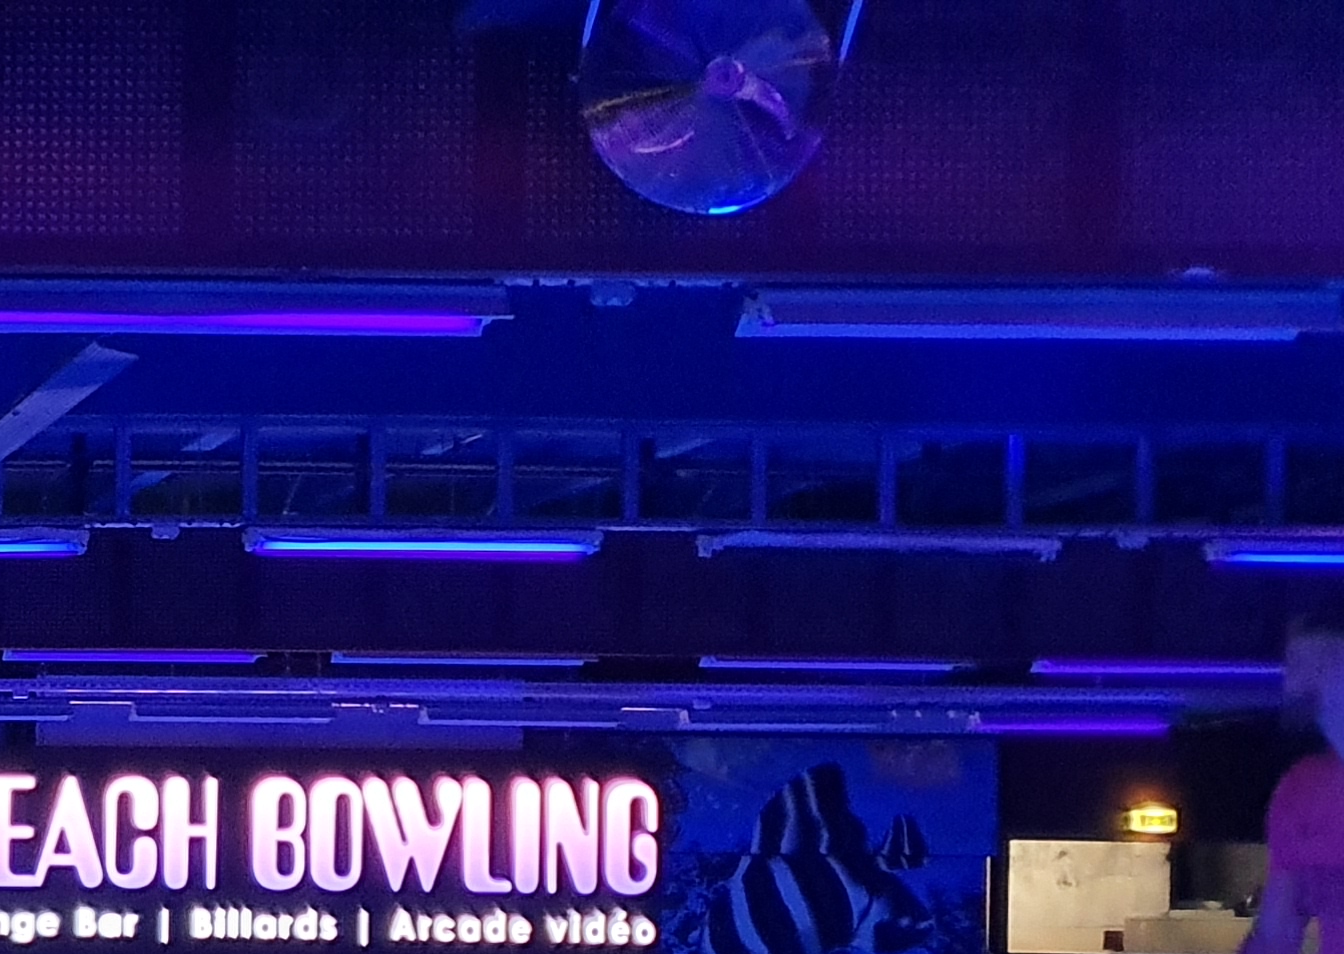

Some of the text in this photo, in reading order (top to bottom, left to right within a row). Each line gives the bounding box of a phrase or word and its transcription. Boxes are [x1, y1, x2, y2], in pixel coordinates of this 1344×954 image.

[250, 775, 660, 896] BOWLING
[72, 906, 140, 939] Bar
[189, 905, 339, 941] Billards
[389, 907, 532, 945] Arcade
[545, 907, 659, 946] vidéo
